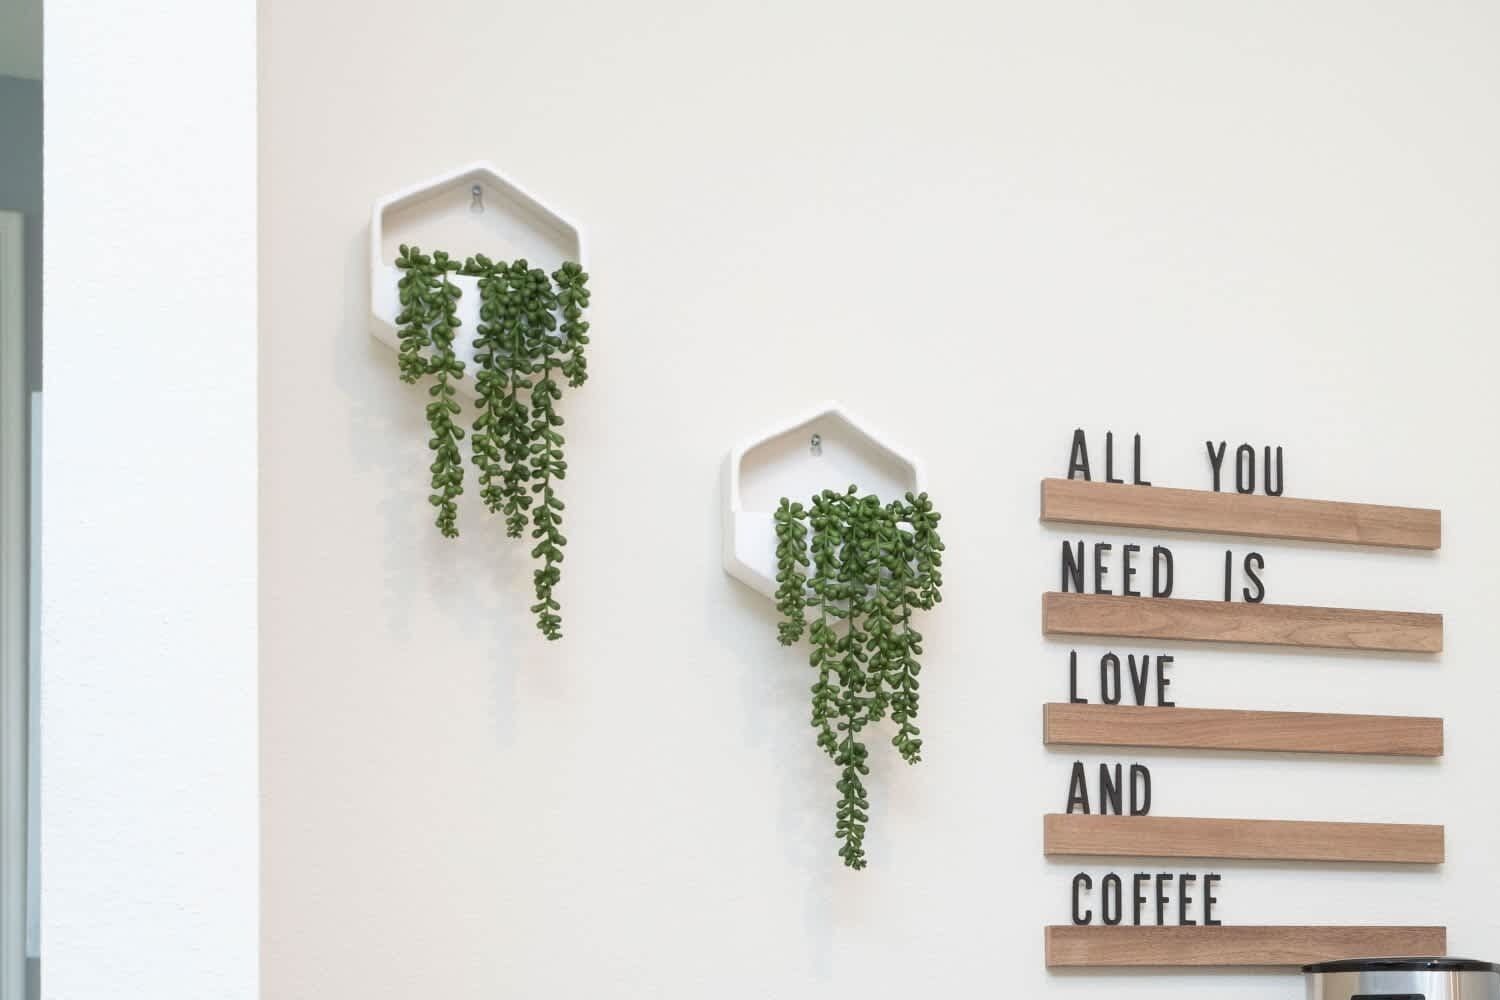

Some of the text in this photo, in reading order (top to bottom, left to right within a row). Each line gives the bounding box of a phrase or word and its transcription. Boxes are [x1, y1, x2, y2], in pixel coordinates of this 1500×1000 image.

[1067, 427, 1284, 496] ALL YOU
[1061, 540, 1265, 603] NEED IS
[1068, 649, 1175, 707] LOVE
[1066, 760, 1152, 816] AND
[1072, 871, 1222, 925] COFFEE
